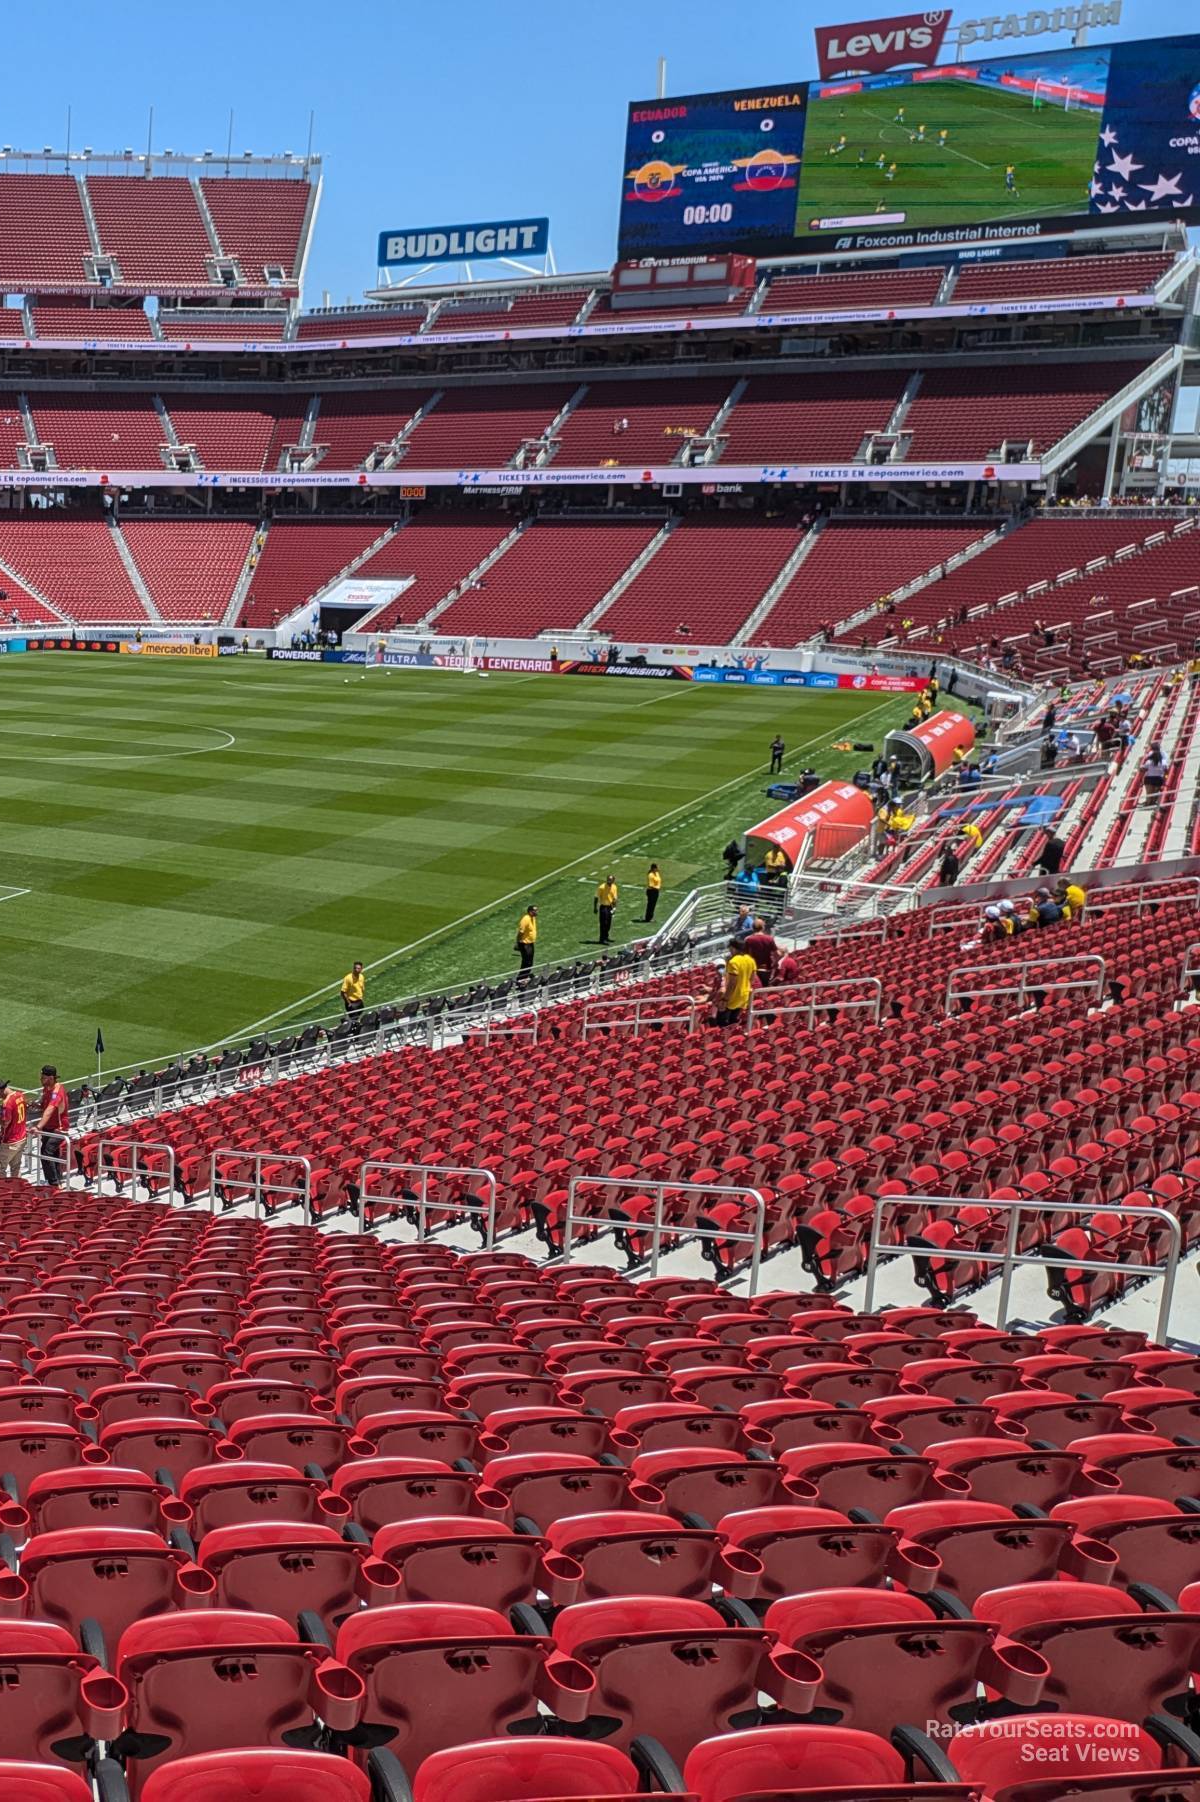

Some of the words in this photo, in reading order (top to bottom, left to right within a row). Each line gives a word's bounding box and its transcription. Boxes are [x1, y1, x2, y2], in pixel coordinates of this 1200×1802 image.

[960, 1, 1121, 43] STADIUM
[734, 95, 801, 112] VENEZUELA
[632, 107, 688, 123] ECUADOR
[760, 119, 774, 132] 0
[652, 131, 665, 144] 0
[1169, 137, 1199, 148] COPA
[684, 203, 733, 225] 00:00
[856, 235, 914, 249] Foxconn
[917, 227, 982, 244] Industrial
[985, 223, 1041, 239] Internet
[387, 233, 448, 260] BUD
[449, 225, 538, 255] LIGHT
[959, 250, 976, 259] BUD
[977, 249, 1002, 258] LIGHT
[671, 256, 708, 266] STADIUM
[4, 475, 14, 483] EN
[16, 476, 87, 485] copaamerica.com
[498, 474, 530, 482] TICKETS
[532, 474, 543, 482] AT
[545, 473, 626, 483] copaamerica.com
[809, 470, 849, 478] TICKETS
[852, 469, 865, 478] EN
[868, 469, 964, 481] copaamerica.com
[229, 476, 269, 484] INGRESSOS
[270, 476, 282, 484] EM
[283, 476, 350, 486] copaamerica.com
[402, 487, 426, 498] 00:00
[702, 484, 715, 493] us
[717, 484, 743, 493] bank
[145, 644, 188, 654] mercado
[189, 645, 211, 655] libre
[272, 650, 322, 661] POWERADE
[384, 655, 418, 665] ULTRA
[444, 657, 485, 668] TEQUILA
[488, 659, 553, 671] CENTENARIO
[17, 1103, 25, 1125] 10
[1051, 1290, 1061, 1298] 20
